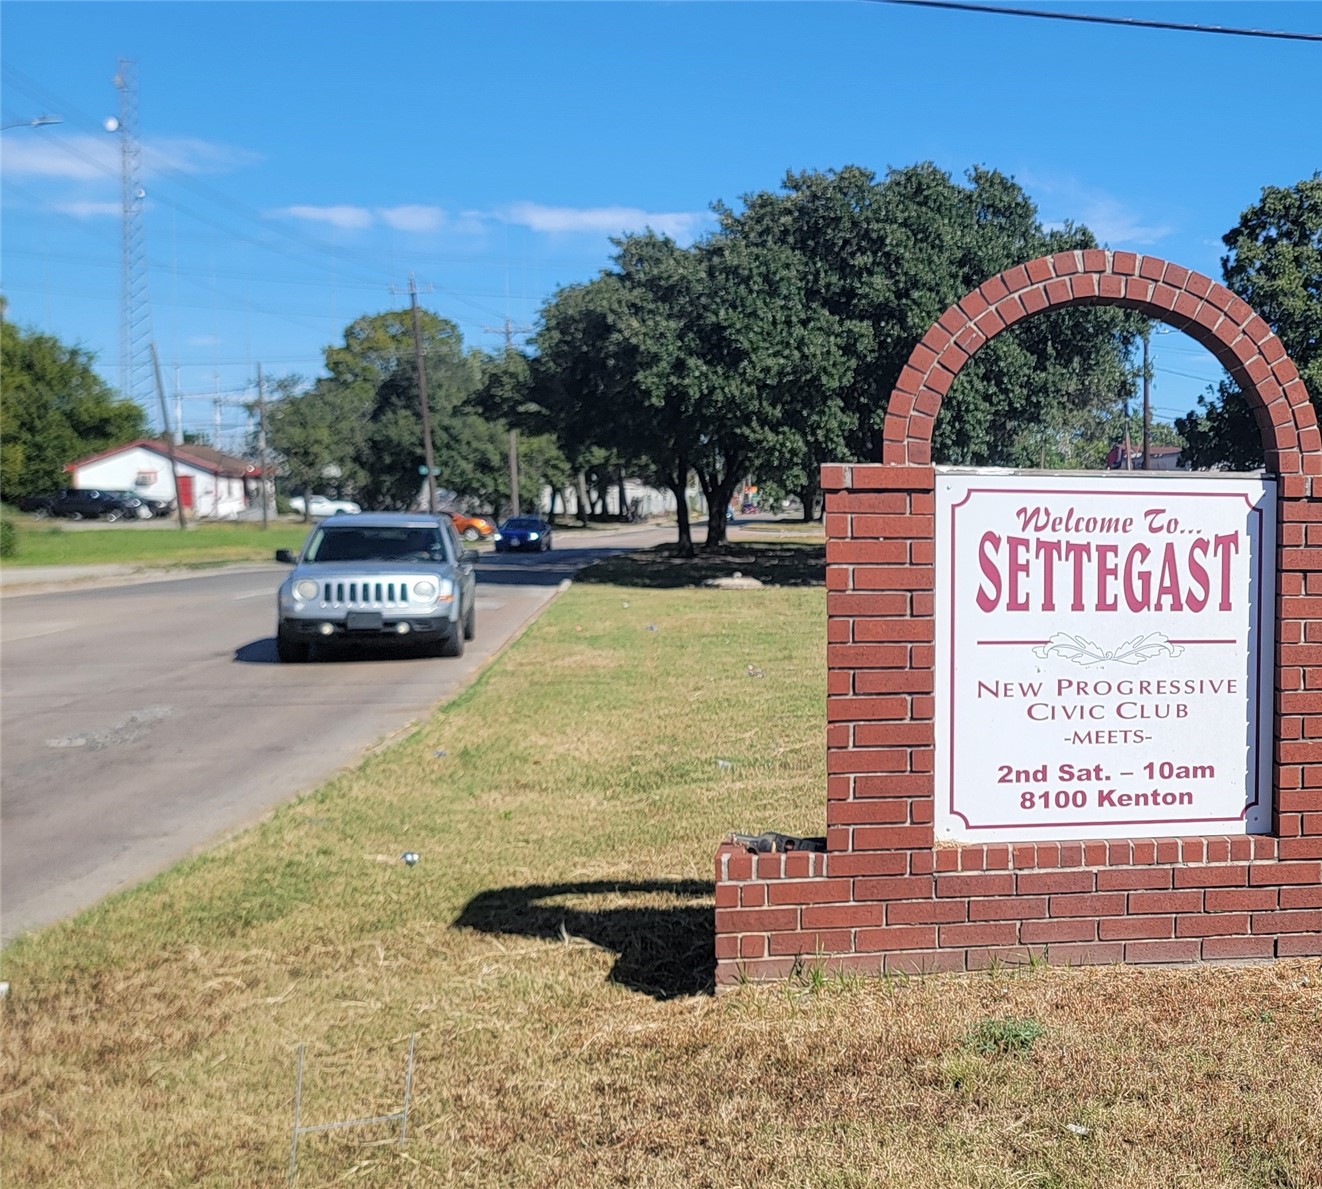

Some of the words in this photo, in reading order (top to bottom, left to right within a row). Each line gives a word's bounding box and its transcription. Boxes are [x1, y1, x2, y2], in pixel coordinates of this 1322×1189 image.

[1015, 506, 1134, 533] Welcome
[1143, 508, 1202, 534] To...
[975, 530, 1240, 614] SETTEGAST
[977, 680, 1043, 699] NEW
[1057, 677, 1238, 698] PROGRESSIVE
[1026, 702, 1105, 721] CIVIC
[1115, 701, 1189, 720] CLUB
[1064, 729, 1153, 746] -MEETS-
[997, 764, 1048, 784] 2nd
[1057, 763, 1111, 783] Sat.
[1143, 761, 1215, 781] 10am
[1019, 789, 1088, 810] 8100
[1097, 788, 1193, 808] Kenton
